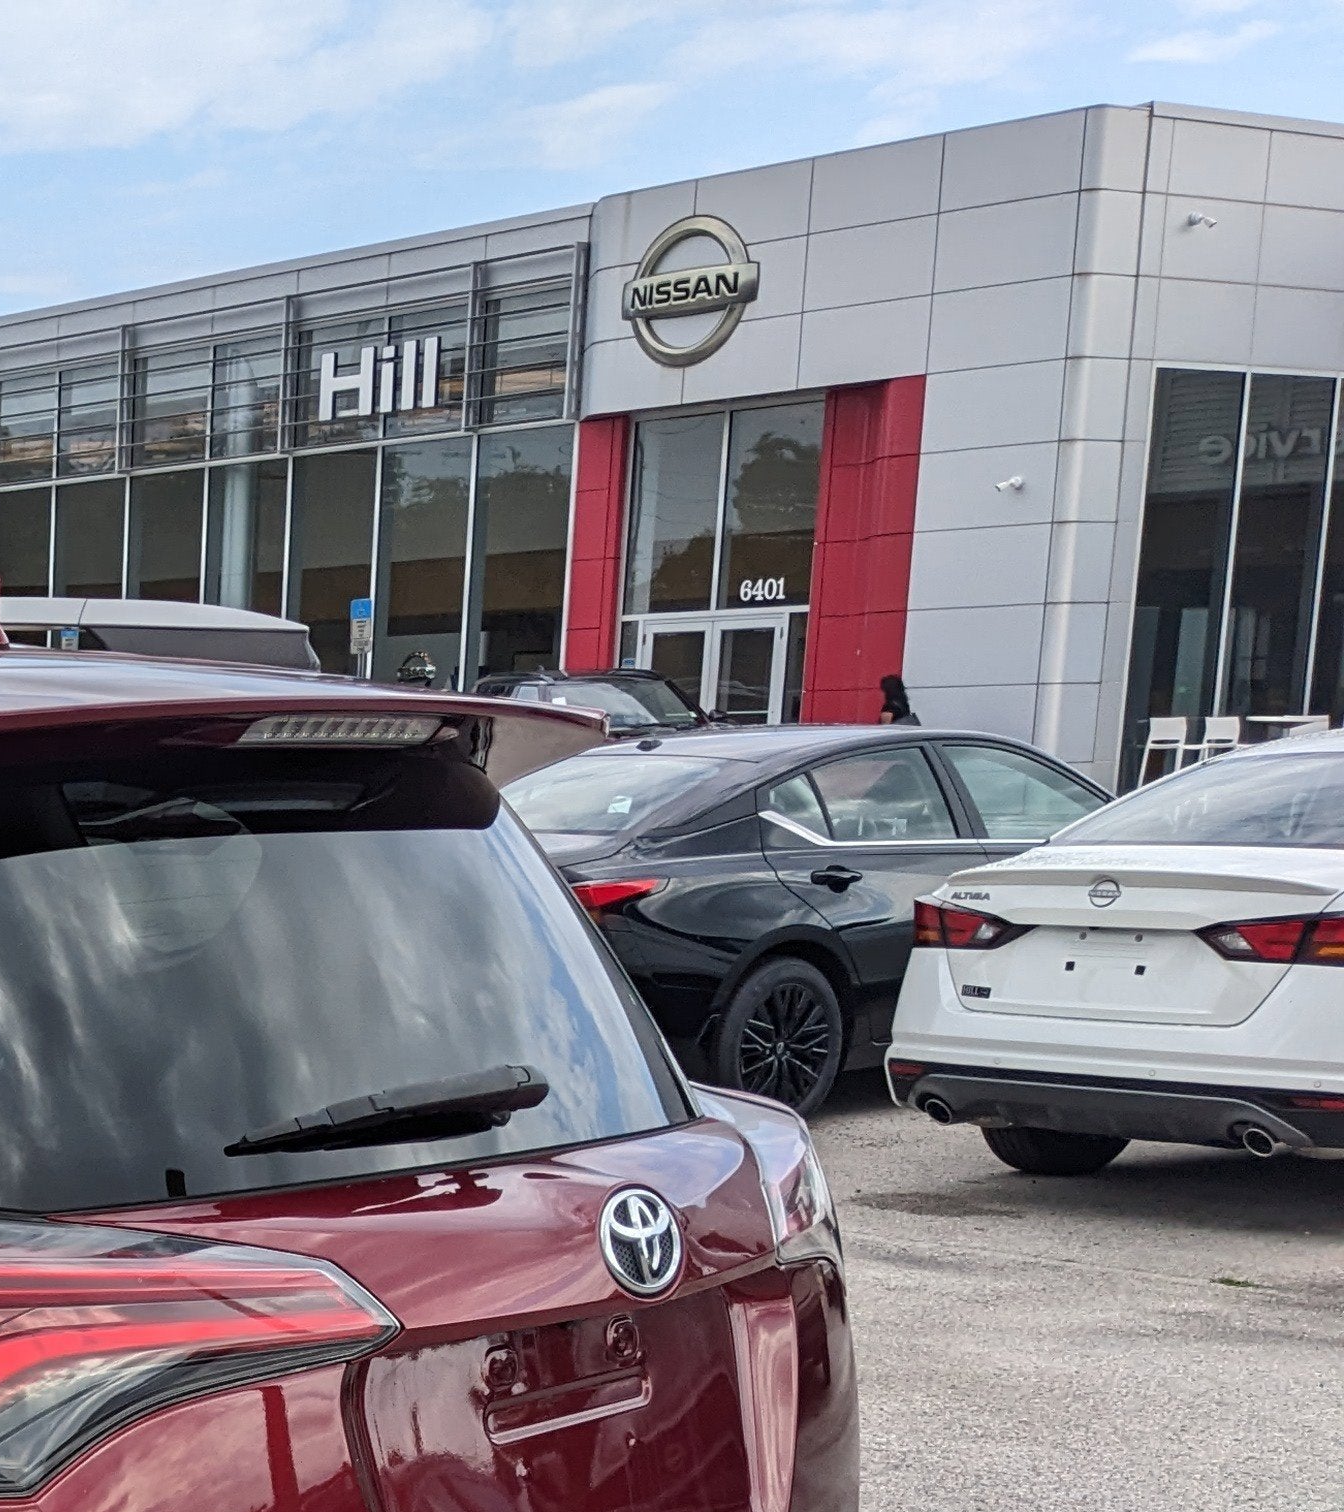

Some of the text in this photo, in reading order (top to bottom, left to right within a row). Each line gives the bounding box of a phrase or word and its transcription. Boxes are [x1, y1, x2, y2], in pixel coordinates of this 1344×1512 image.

[631, 271, 739, 309] NISSAN
[319, 336, 441, 422] Hill
[739, 577, 786, 602] 6401
